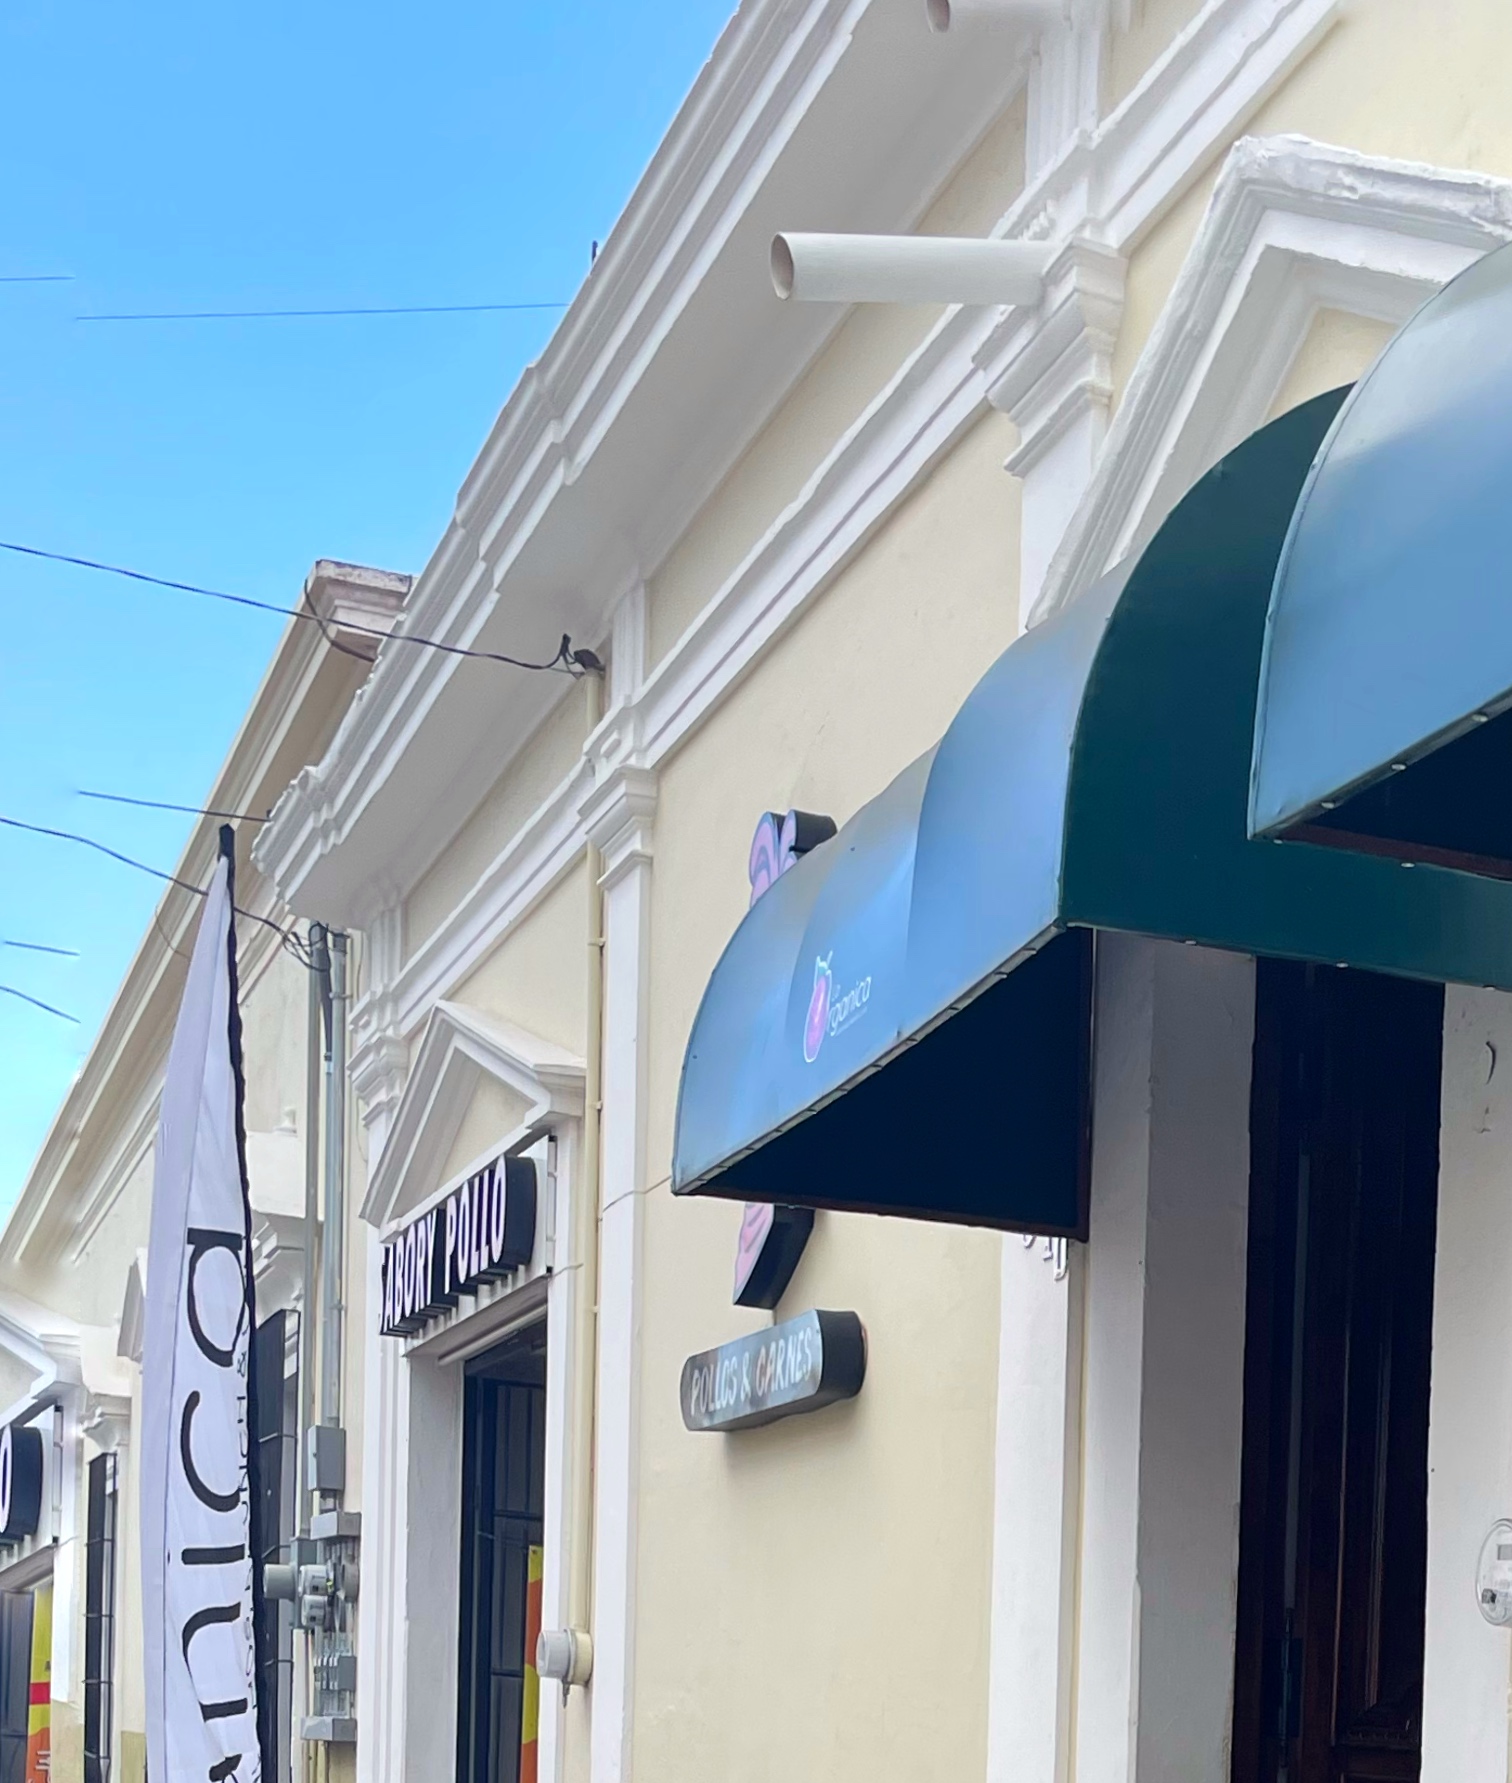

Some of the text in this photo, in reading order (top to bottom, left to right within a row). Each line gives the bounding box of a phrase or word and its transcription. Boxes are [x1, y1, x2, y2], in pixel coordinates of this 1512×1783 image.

[444, 1153, 508, 1296] POLLO
[690, 1326, 812, 1417] POLLOS & CARNES
